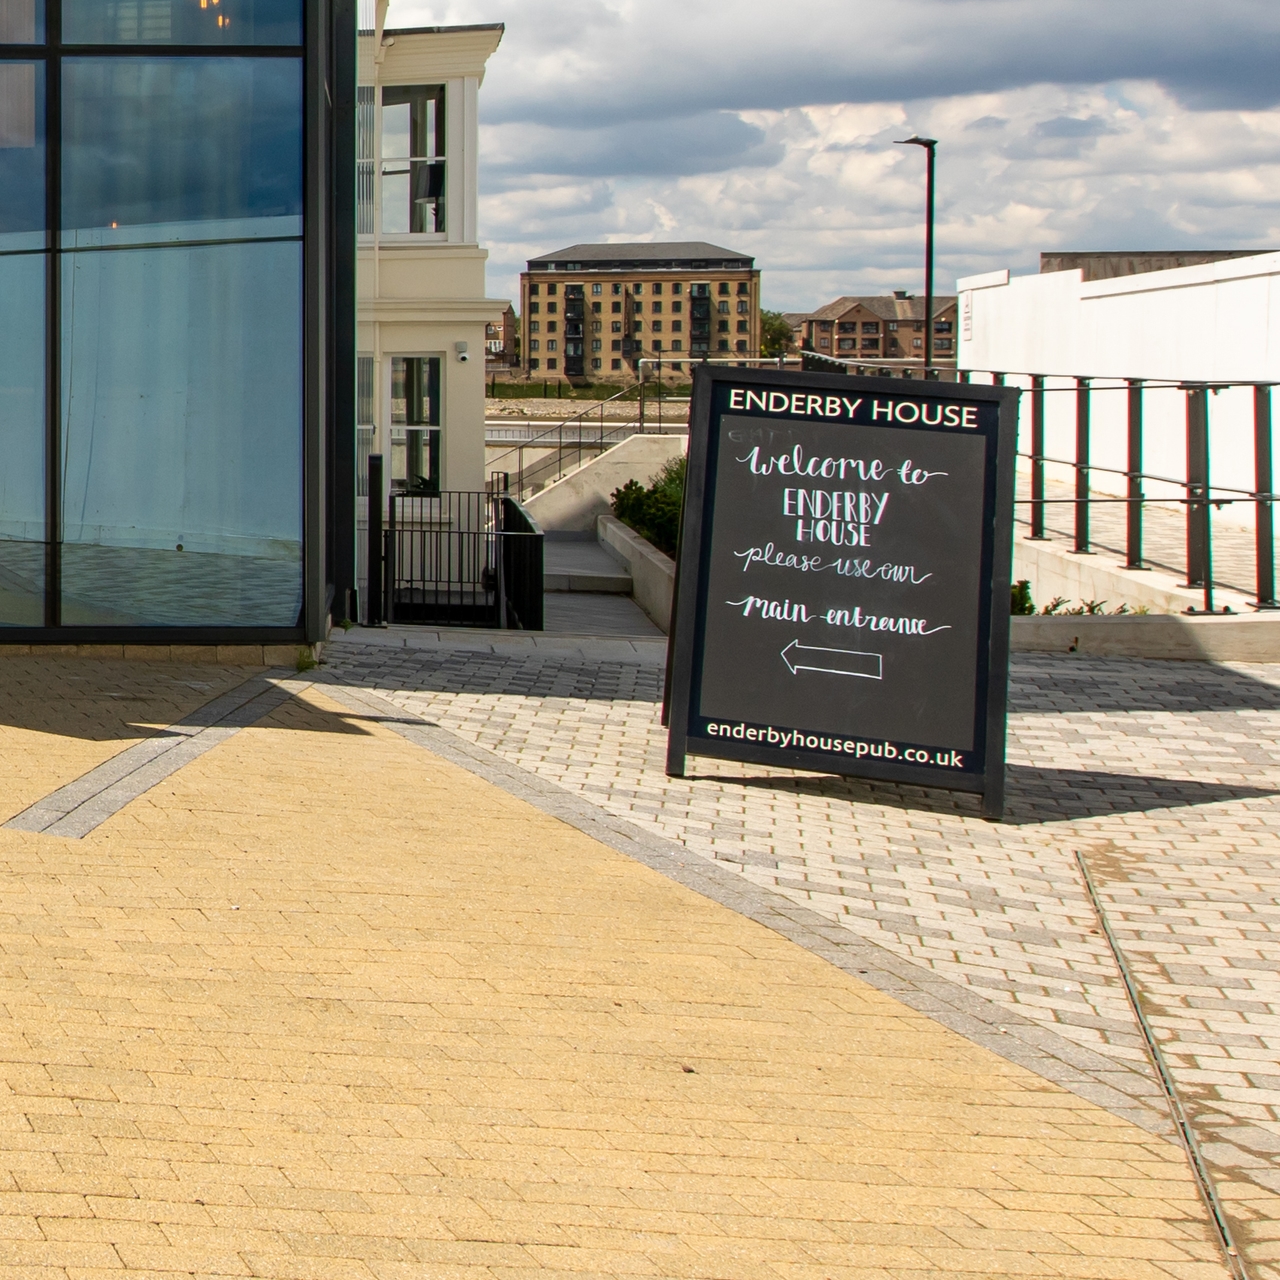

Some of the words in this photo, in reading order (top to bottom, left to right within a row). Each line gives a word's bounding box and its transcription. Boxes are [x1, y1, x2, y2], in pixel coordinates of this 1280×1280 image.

[729, 388, 863, 418] ENDERBY
[872, 400, 978, 428] HOUSE
[735, 444, 893, 480] welcome
[897, 459, 949, 484] to
[783, 488, 889, 524] ENDERBY
[796, 519, 871, 546] HOUSE
[734, 542, 829, 571] please
[830, 558, 878, 578] use
[878, 562, 933, 584] our
[725, 595, 817, 622] main
[820, 606, 952, 635] entrance
[706, 722, 964, 768] enderbyhousepub.co.uk
